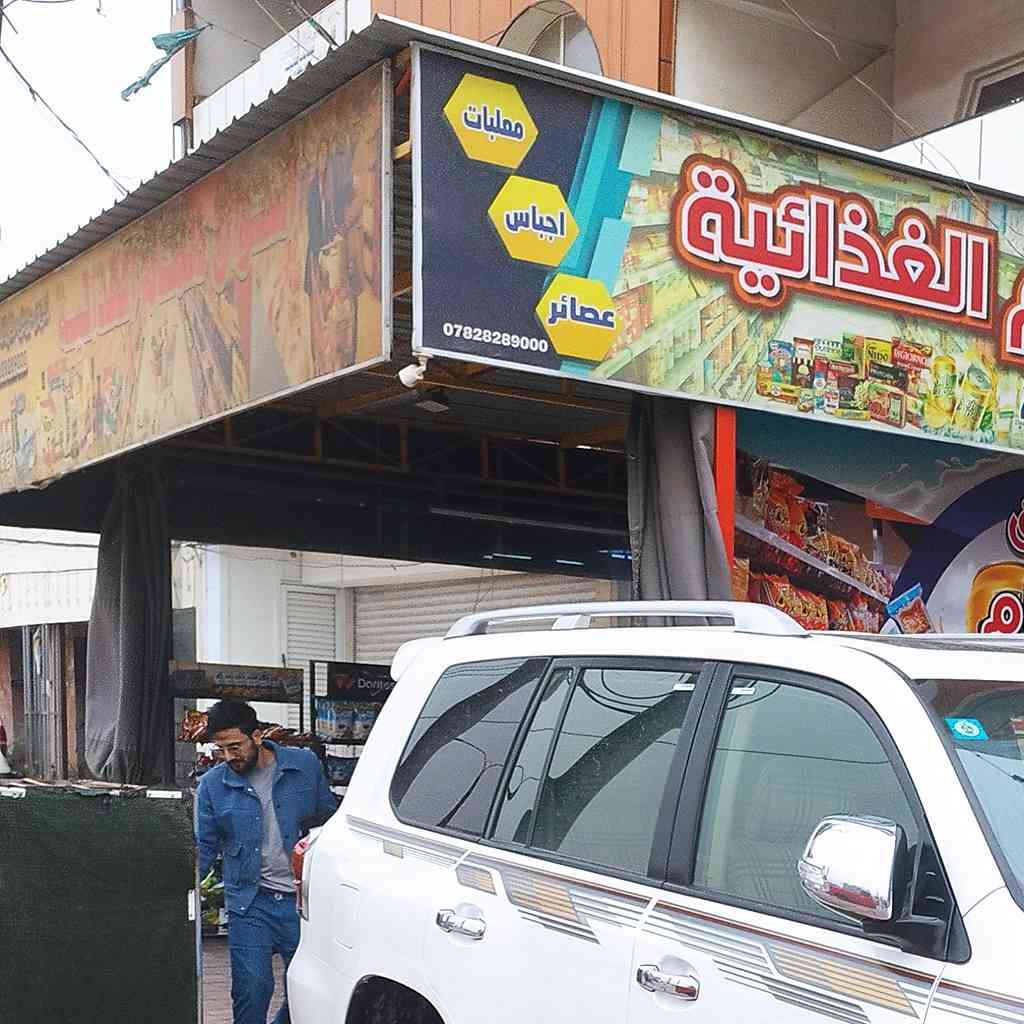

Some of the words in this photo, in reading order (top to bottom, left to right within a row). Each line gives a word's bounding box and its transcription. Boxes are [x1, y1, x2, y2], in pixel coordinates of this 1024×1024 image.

[463, 105, 524, 141] معلبات
[681, 164, 989, 321] الغذائية
[548, 295, 616, 328] عصائر
[442, 322, 549, 353] 07828289000
